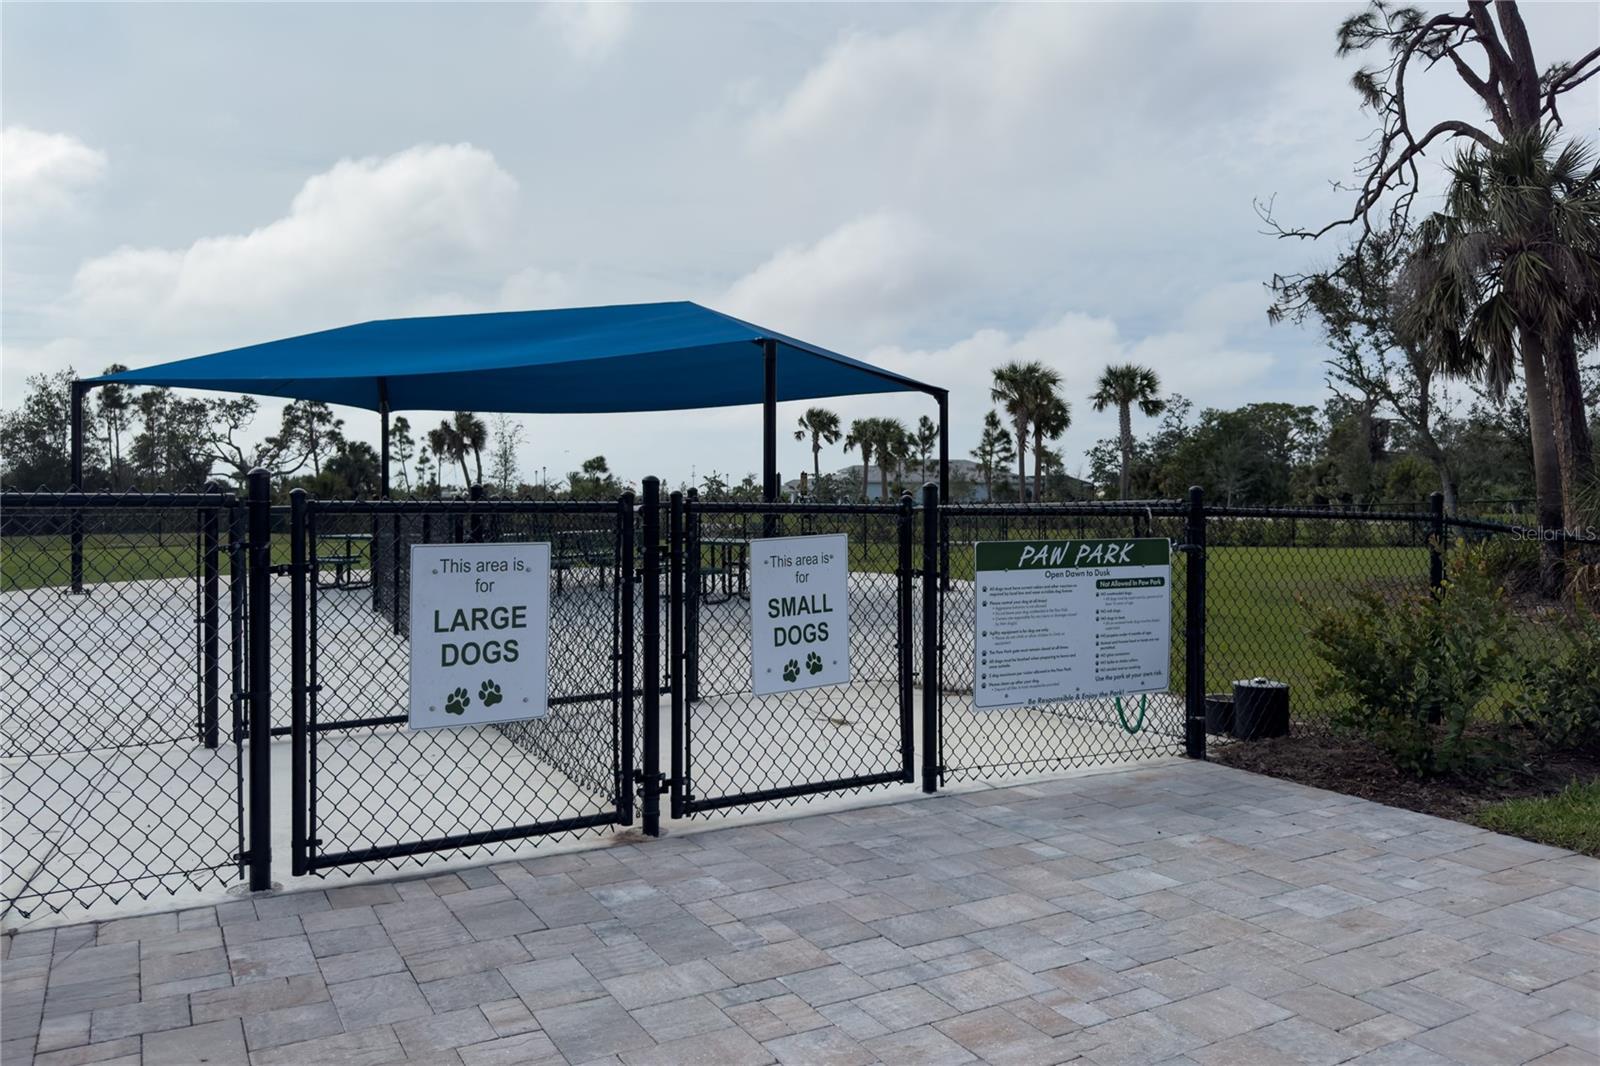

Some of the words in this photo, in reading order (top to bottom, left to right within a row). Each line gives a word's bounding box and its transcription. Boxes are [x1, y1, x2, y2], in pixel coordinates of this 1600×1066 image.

[770, 555, 793, 568] This
[795, 555, 818, 566] area
[821, 552, 830, 564] is
[1018, 541, 1070, 567] PAW
[1074, 543, 1134, 565] PARK
[440, 558, 471, 574] This
[476, 560, 508, 573] area
[513, 557, 525, 572] is
[1044, 570, 1064, 580] Open
[1065, 570, 1085, 578] Dawn
[1094, 569, 1111, 577] Dusk
[475, 578, 495, 593] for
[795, 571, 809, 584] for
[768, 594, 833, 619] SMALL
[434, 606, 527, 633] LARGE
[774, 621, 829, 647] DOGS
[441, 639, 519, 667] DOGS
